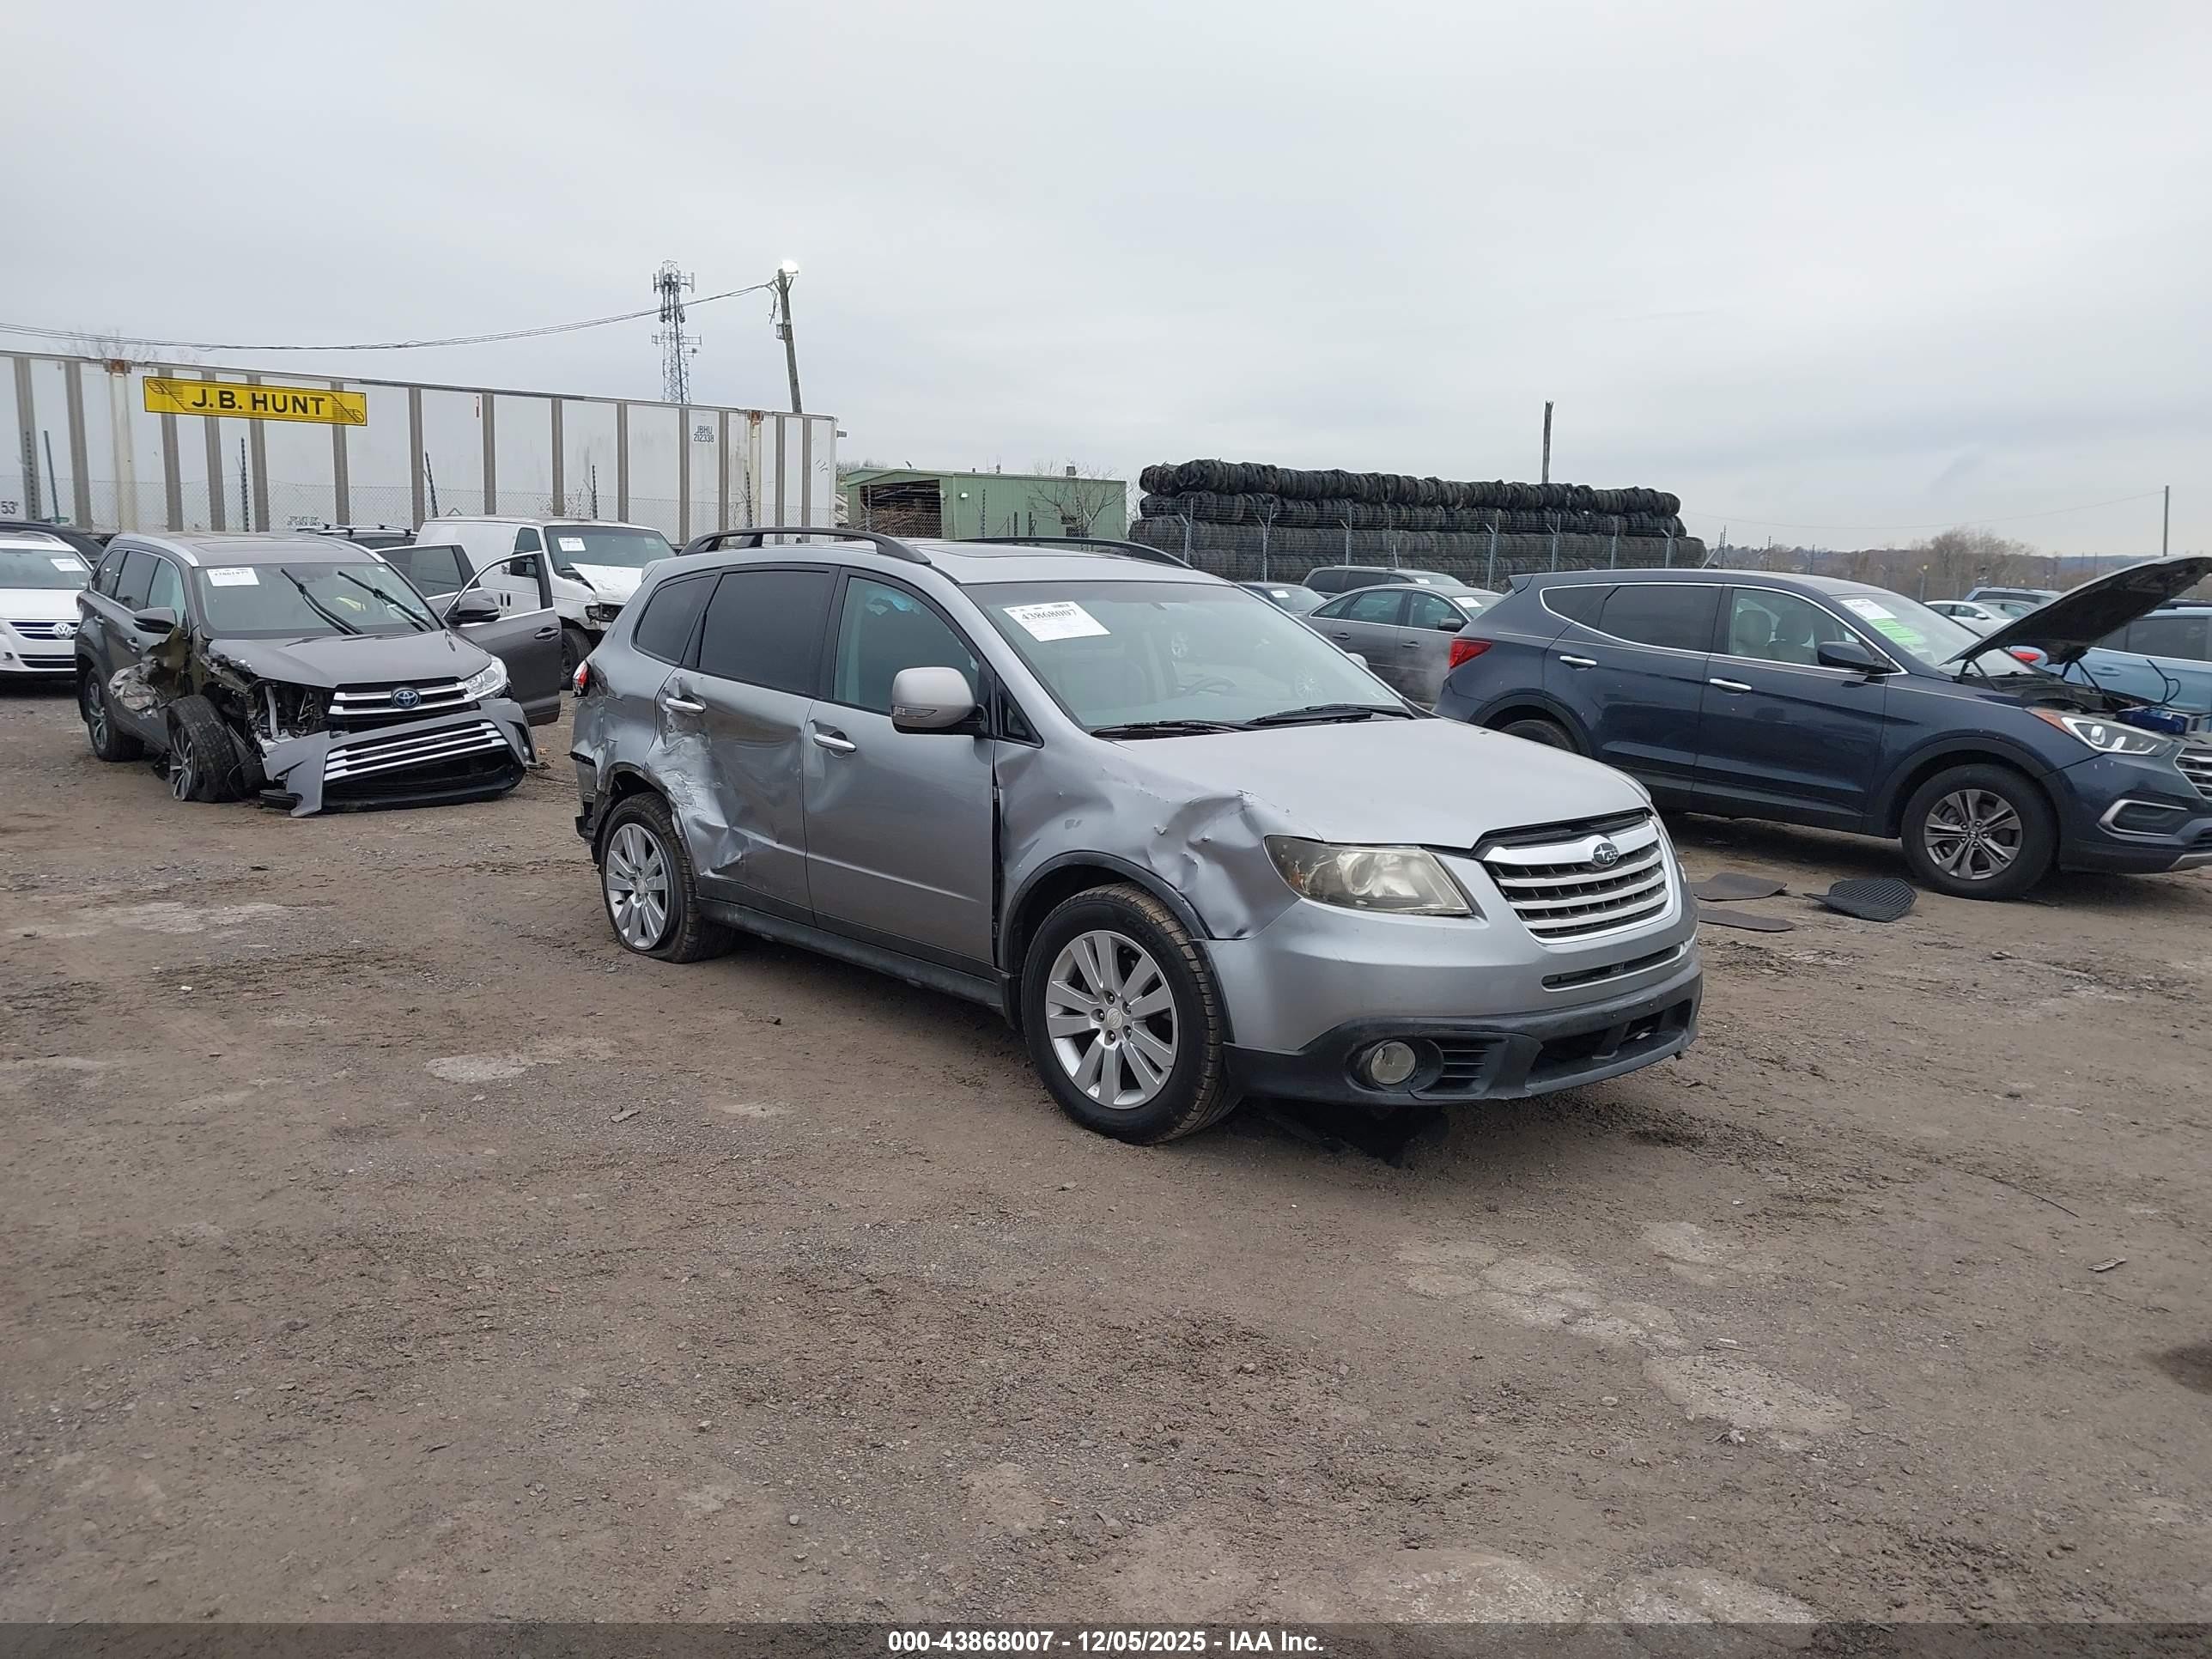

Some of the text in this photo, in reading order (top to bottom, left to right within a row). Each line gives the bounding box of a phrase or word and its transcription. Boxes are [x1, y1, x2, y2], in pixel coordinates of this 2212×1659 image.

[191, 388, 325, 416] J.B. HUNT
[695, 425, 713, 434] JBHU
